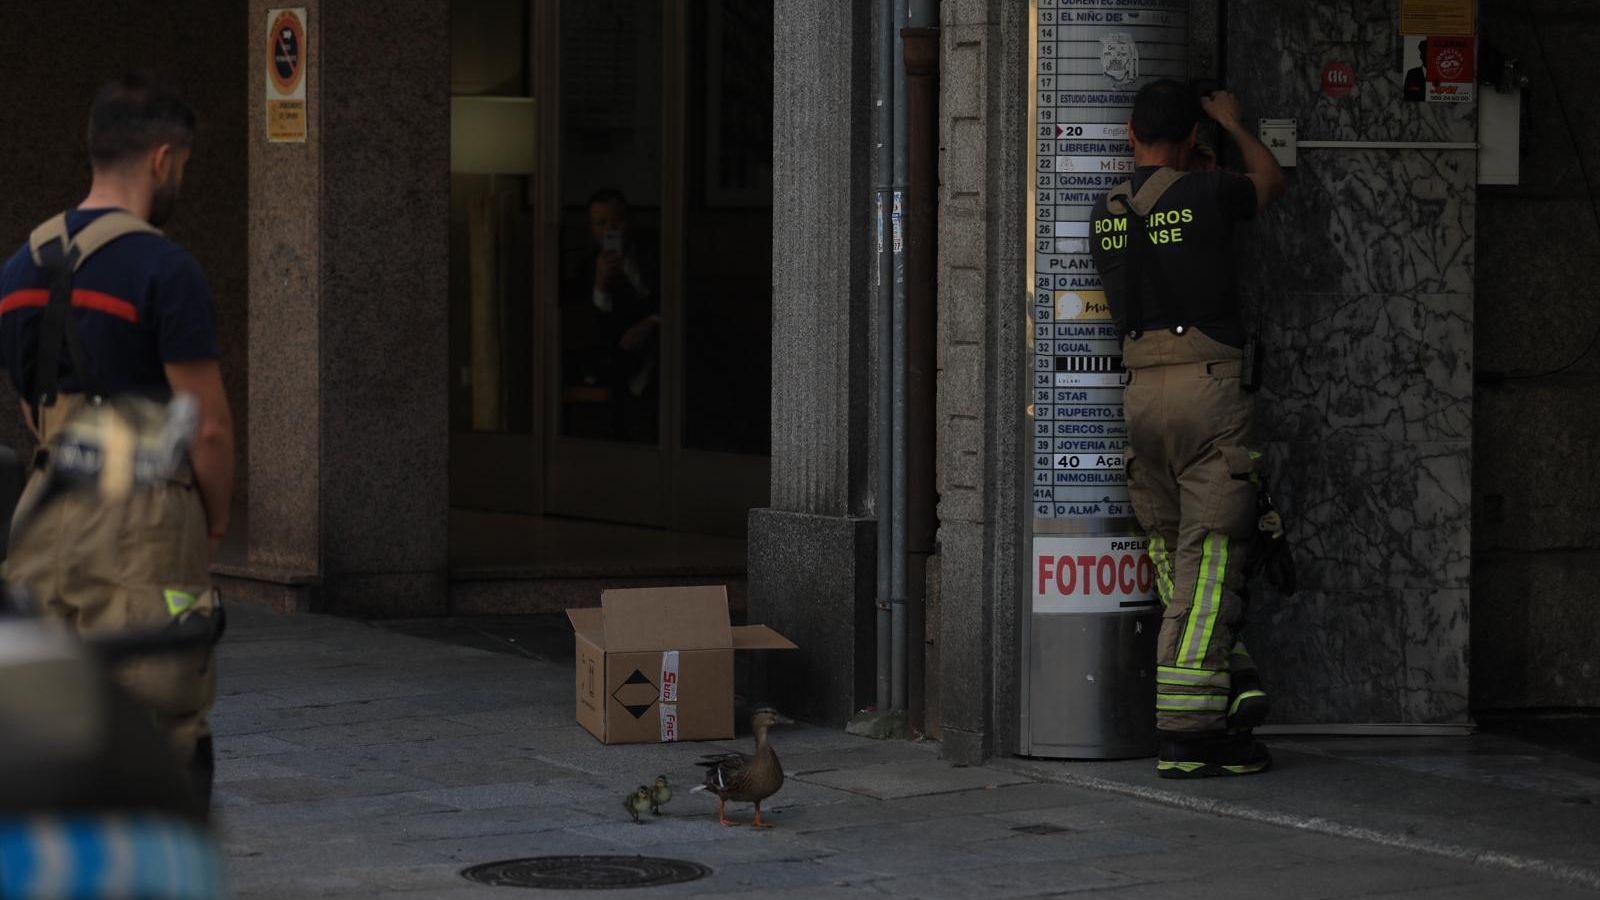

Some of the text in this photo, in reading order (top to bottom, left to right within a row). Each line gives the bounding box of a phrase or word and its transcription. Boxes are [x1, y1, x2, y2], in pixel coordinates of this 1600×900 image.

[1041, 13, 1052, 21] 13
[1061, 13, 1073, 21] EL
[1076, 11, 1103, 22] NIÑO
[1041, 29, 1052, 38] 14
[1041, 46, 1052, 55] 15
[1041, 62, 1052, 70] 16
[1041, 78, 1051, 87] 17
[1041, 94, 1051, 104] 18
[1040, 111, 1051, 120] 19
[1040, 127, 1051, 136] 20
[1066, 127, 1083, 136] 20
[1040, 143, 1134, 153] 21 LIBRERIA INFA
[1040, 159, 1050, 168] 22
[1039, 176, 1050, 185] 23
[1059, 176, 1102, 186] GOMAS
[1039, 193, 1050, 201] 24
[1060, 193, 1089, 201] TANITA
[1039, 209, 1050, 217] 25
[1095, 208, 1194, 234] BOMIROS
[1039, 225, 1050, 234] 26
[1101, 228, 1184, 251] OUNSE
[1039, 241, 1050, 250] 27
[1039, 278, 1102, 287] 28 O ALMA
[1038, 294, 1050, 303] 29
[1038, 310, 1049, 319] 30
[1038, 327, 1049, 336] 31
[1057, 327, 1095, 336] LILIAM
[1038, 343, 1092, 352] 32 IGUAL
[1038, 360, 1049, 368] 33
[1038, 376, 1049, 384] 34
[1038, 392, 1087, 401] 36 STAR
[1038, 408, 1048, 416] 37
[1057, 408, 1114, 418] RUPERTO,
[1038, 425, 1048, 433] 38
[1057, 425, 1104, 434] SERCOS
[1037, 441, 1048, 449] 39
[1057, 441, 1105, 450] JOYERIA
[1037, 457, 1048, 466] 40
[1058, 456, 1080, 467] 40
[1037, 473, 1048, 482] 41
[1033, 489, 1052, 498] 41A
[1037, 505, 1048, 514] 42
[1056, 505, 1065, 514] O
[1038, 553, 1153, 595] FOTOCO
